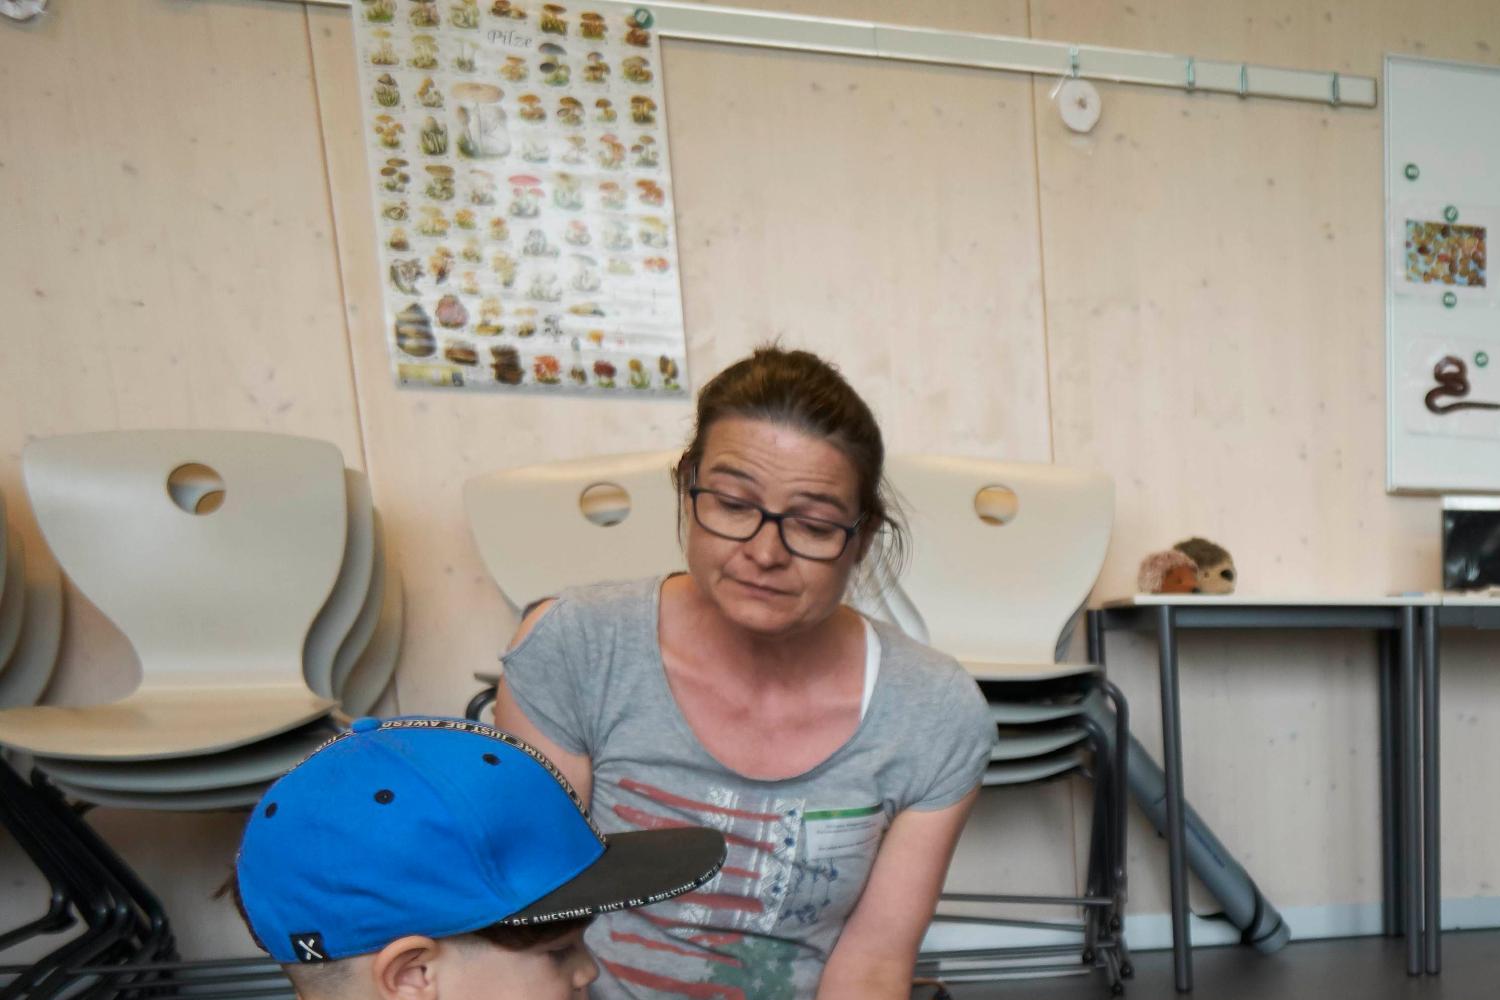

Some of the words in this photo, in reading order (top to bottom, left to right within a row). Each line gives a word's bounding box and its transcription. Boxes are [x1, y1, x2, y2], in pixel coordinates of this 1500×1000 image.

[487, 29, 532, 48] Pilze
[447, 720, 468, 730] BE
[470, 724, 508, 741] JUST
[513, 918, 528, 926] BE
[533, 907, 593, 924] AWESOME
[599, 902, 625, 913] JUST
